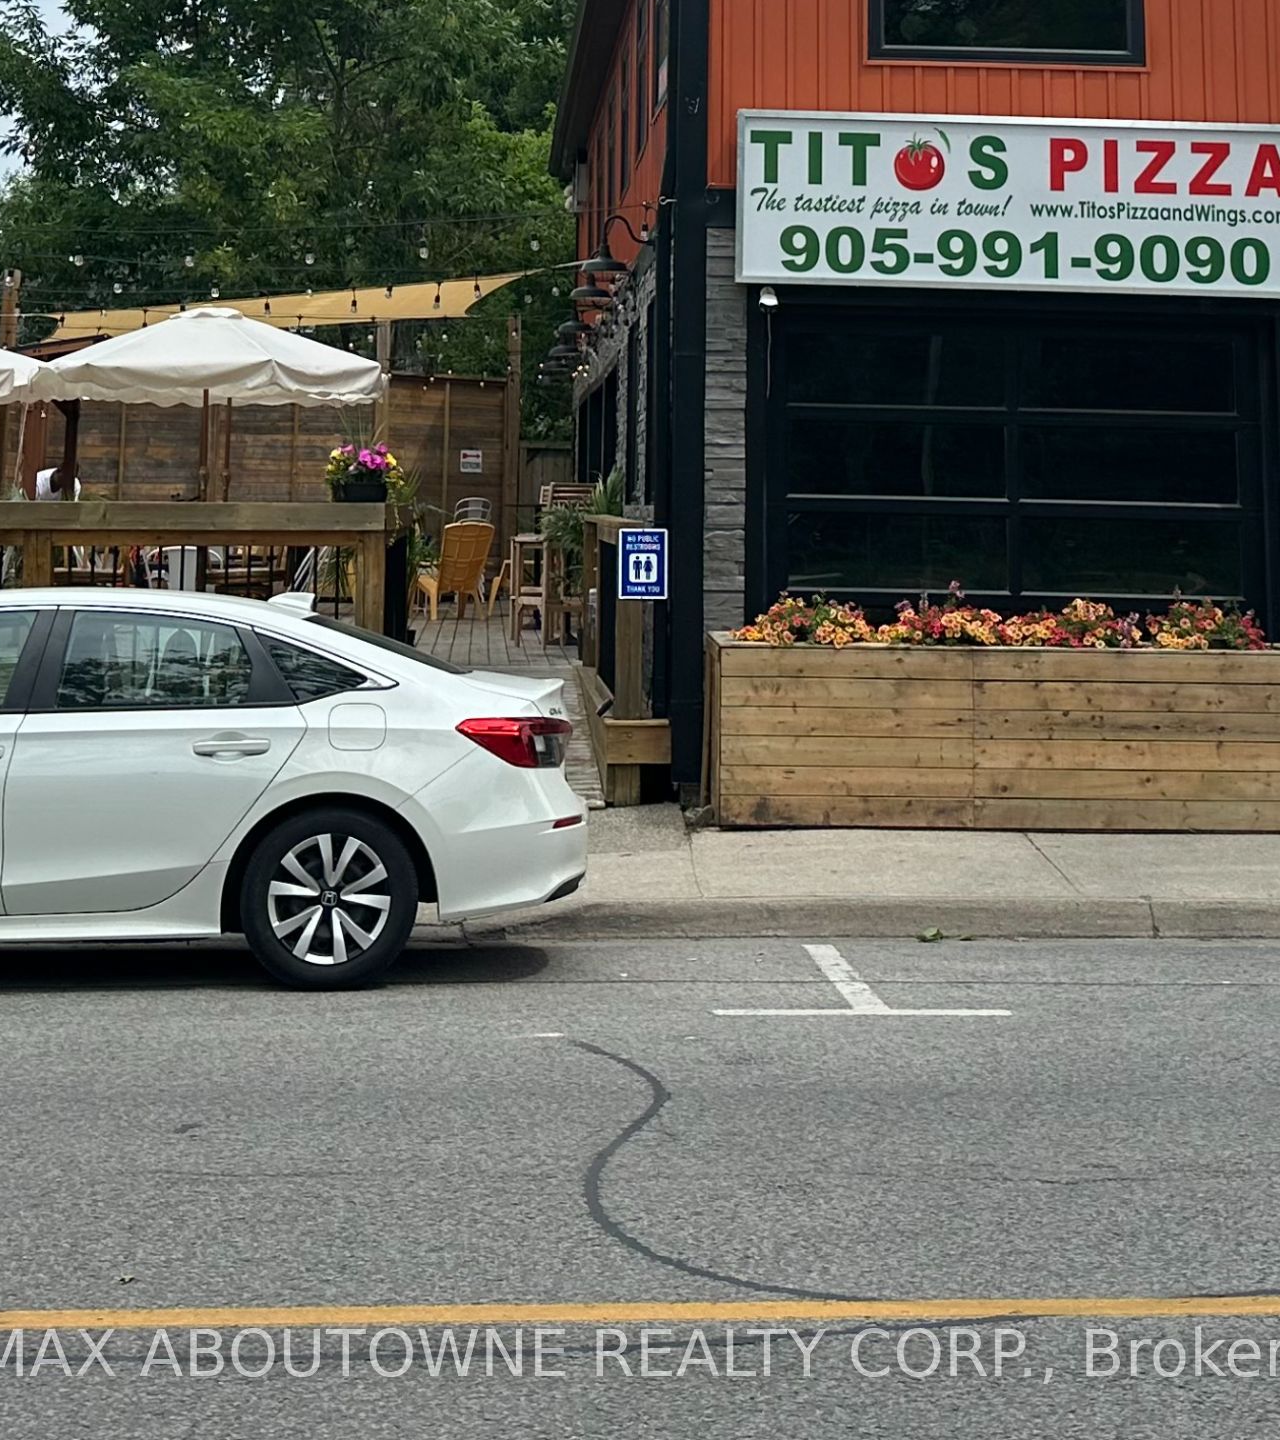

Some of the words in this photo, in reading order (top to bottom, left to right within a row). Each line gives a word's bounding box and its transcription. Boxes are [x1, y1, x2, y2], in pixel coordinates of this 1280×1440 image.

[750, 186, 793, 213] The
[793, 191, 866, 215] tastiest
[869, 199, 923, 223] pizza
[930, 197, 950, 216] in
[956, 195, 1014, 218] town!
[779, 225, 1272, 286] 905-991-9090
